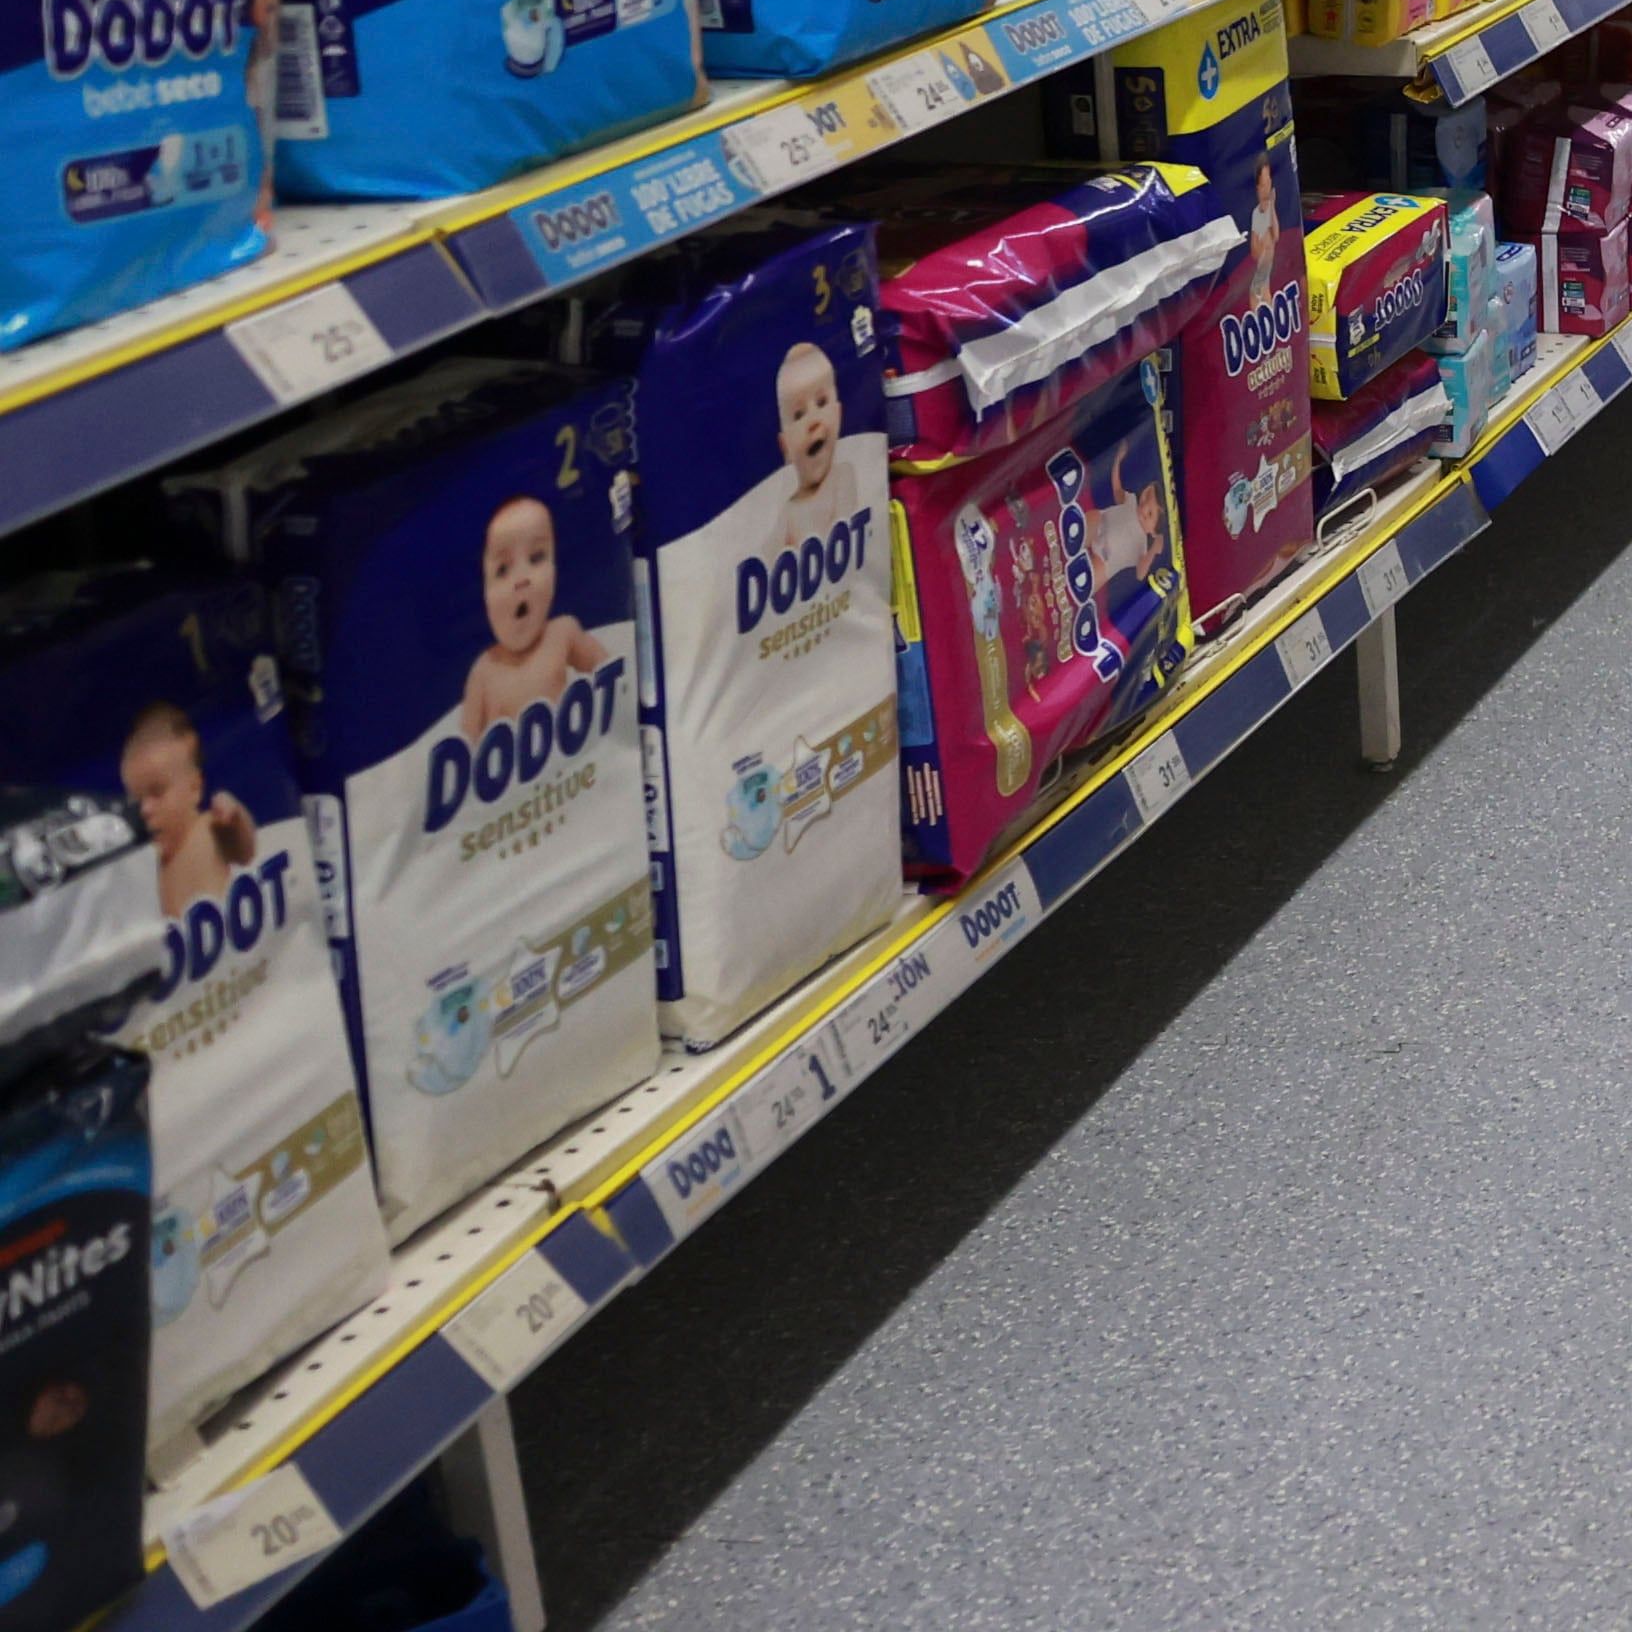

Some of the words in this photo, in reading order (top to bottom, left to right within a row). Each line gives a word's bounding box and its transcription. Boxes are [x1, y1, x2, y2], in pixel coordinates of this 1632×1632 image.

[1005, 10, 1067, 54] DODOT
[1217, 12, 1261, 60] EXTRA
[155, 72, 221, 106] seco
[811, 266, 831, 316] 3
[1221, 280, 1301, 377] DODOT
[1247, 346, 1294, 392] activity
[554, 425, 579, 490] 2
[735, 505, 873, 635] DODOT
[1046, 447, 1124, 683] DODOT
[758, 587, 852, 657] sensitive
[426, 655, 627, 819] DODOT
[460, 761, 597, 861] sensitive
[961, 882, 1021, 949] DODOT
[668, 1128, 737, 1200] DODO
